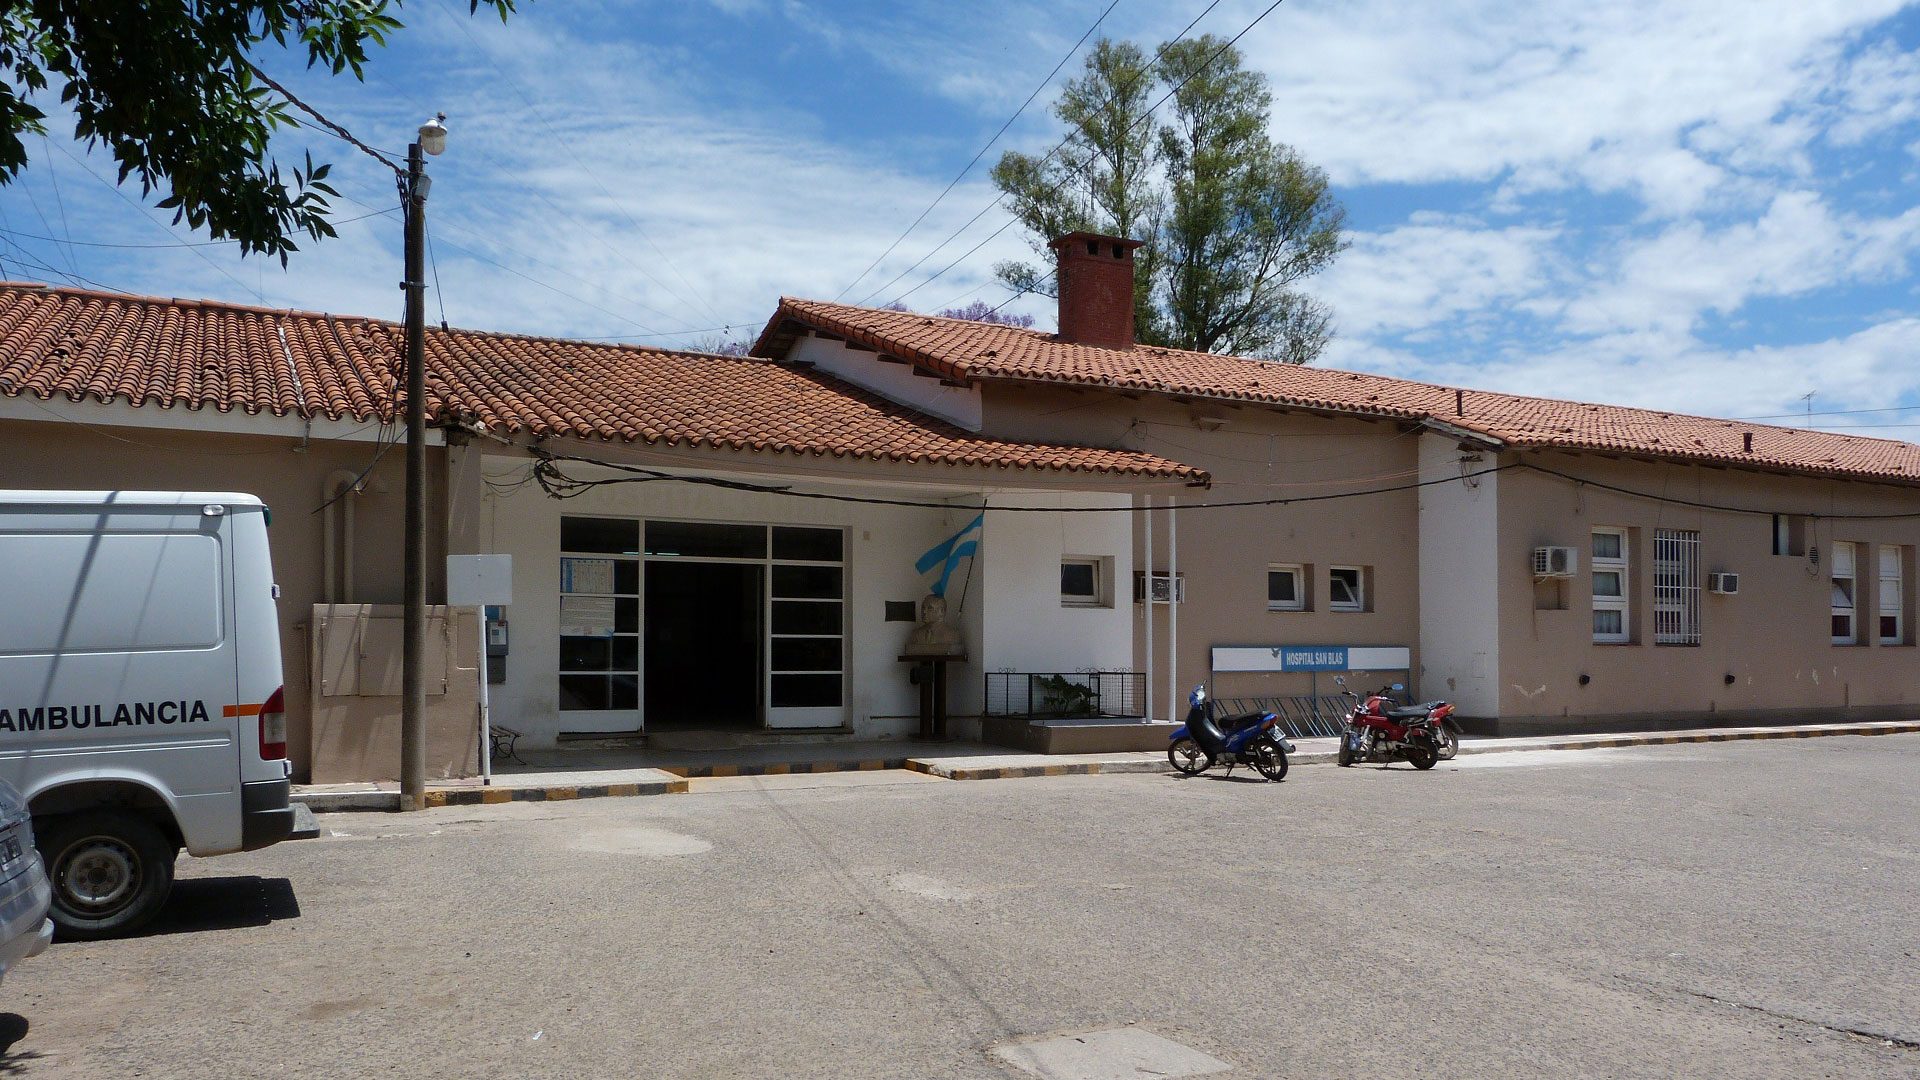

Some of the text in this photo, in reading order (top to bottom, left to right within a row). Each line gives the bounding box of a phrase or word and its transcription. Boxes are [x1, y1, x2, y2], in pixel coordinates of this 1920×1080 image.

[1286, 652, 1343, 665] HOSPITAL SAN BLAS
[0, 700, 210, 732] AMBULANCIA
